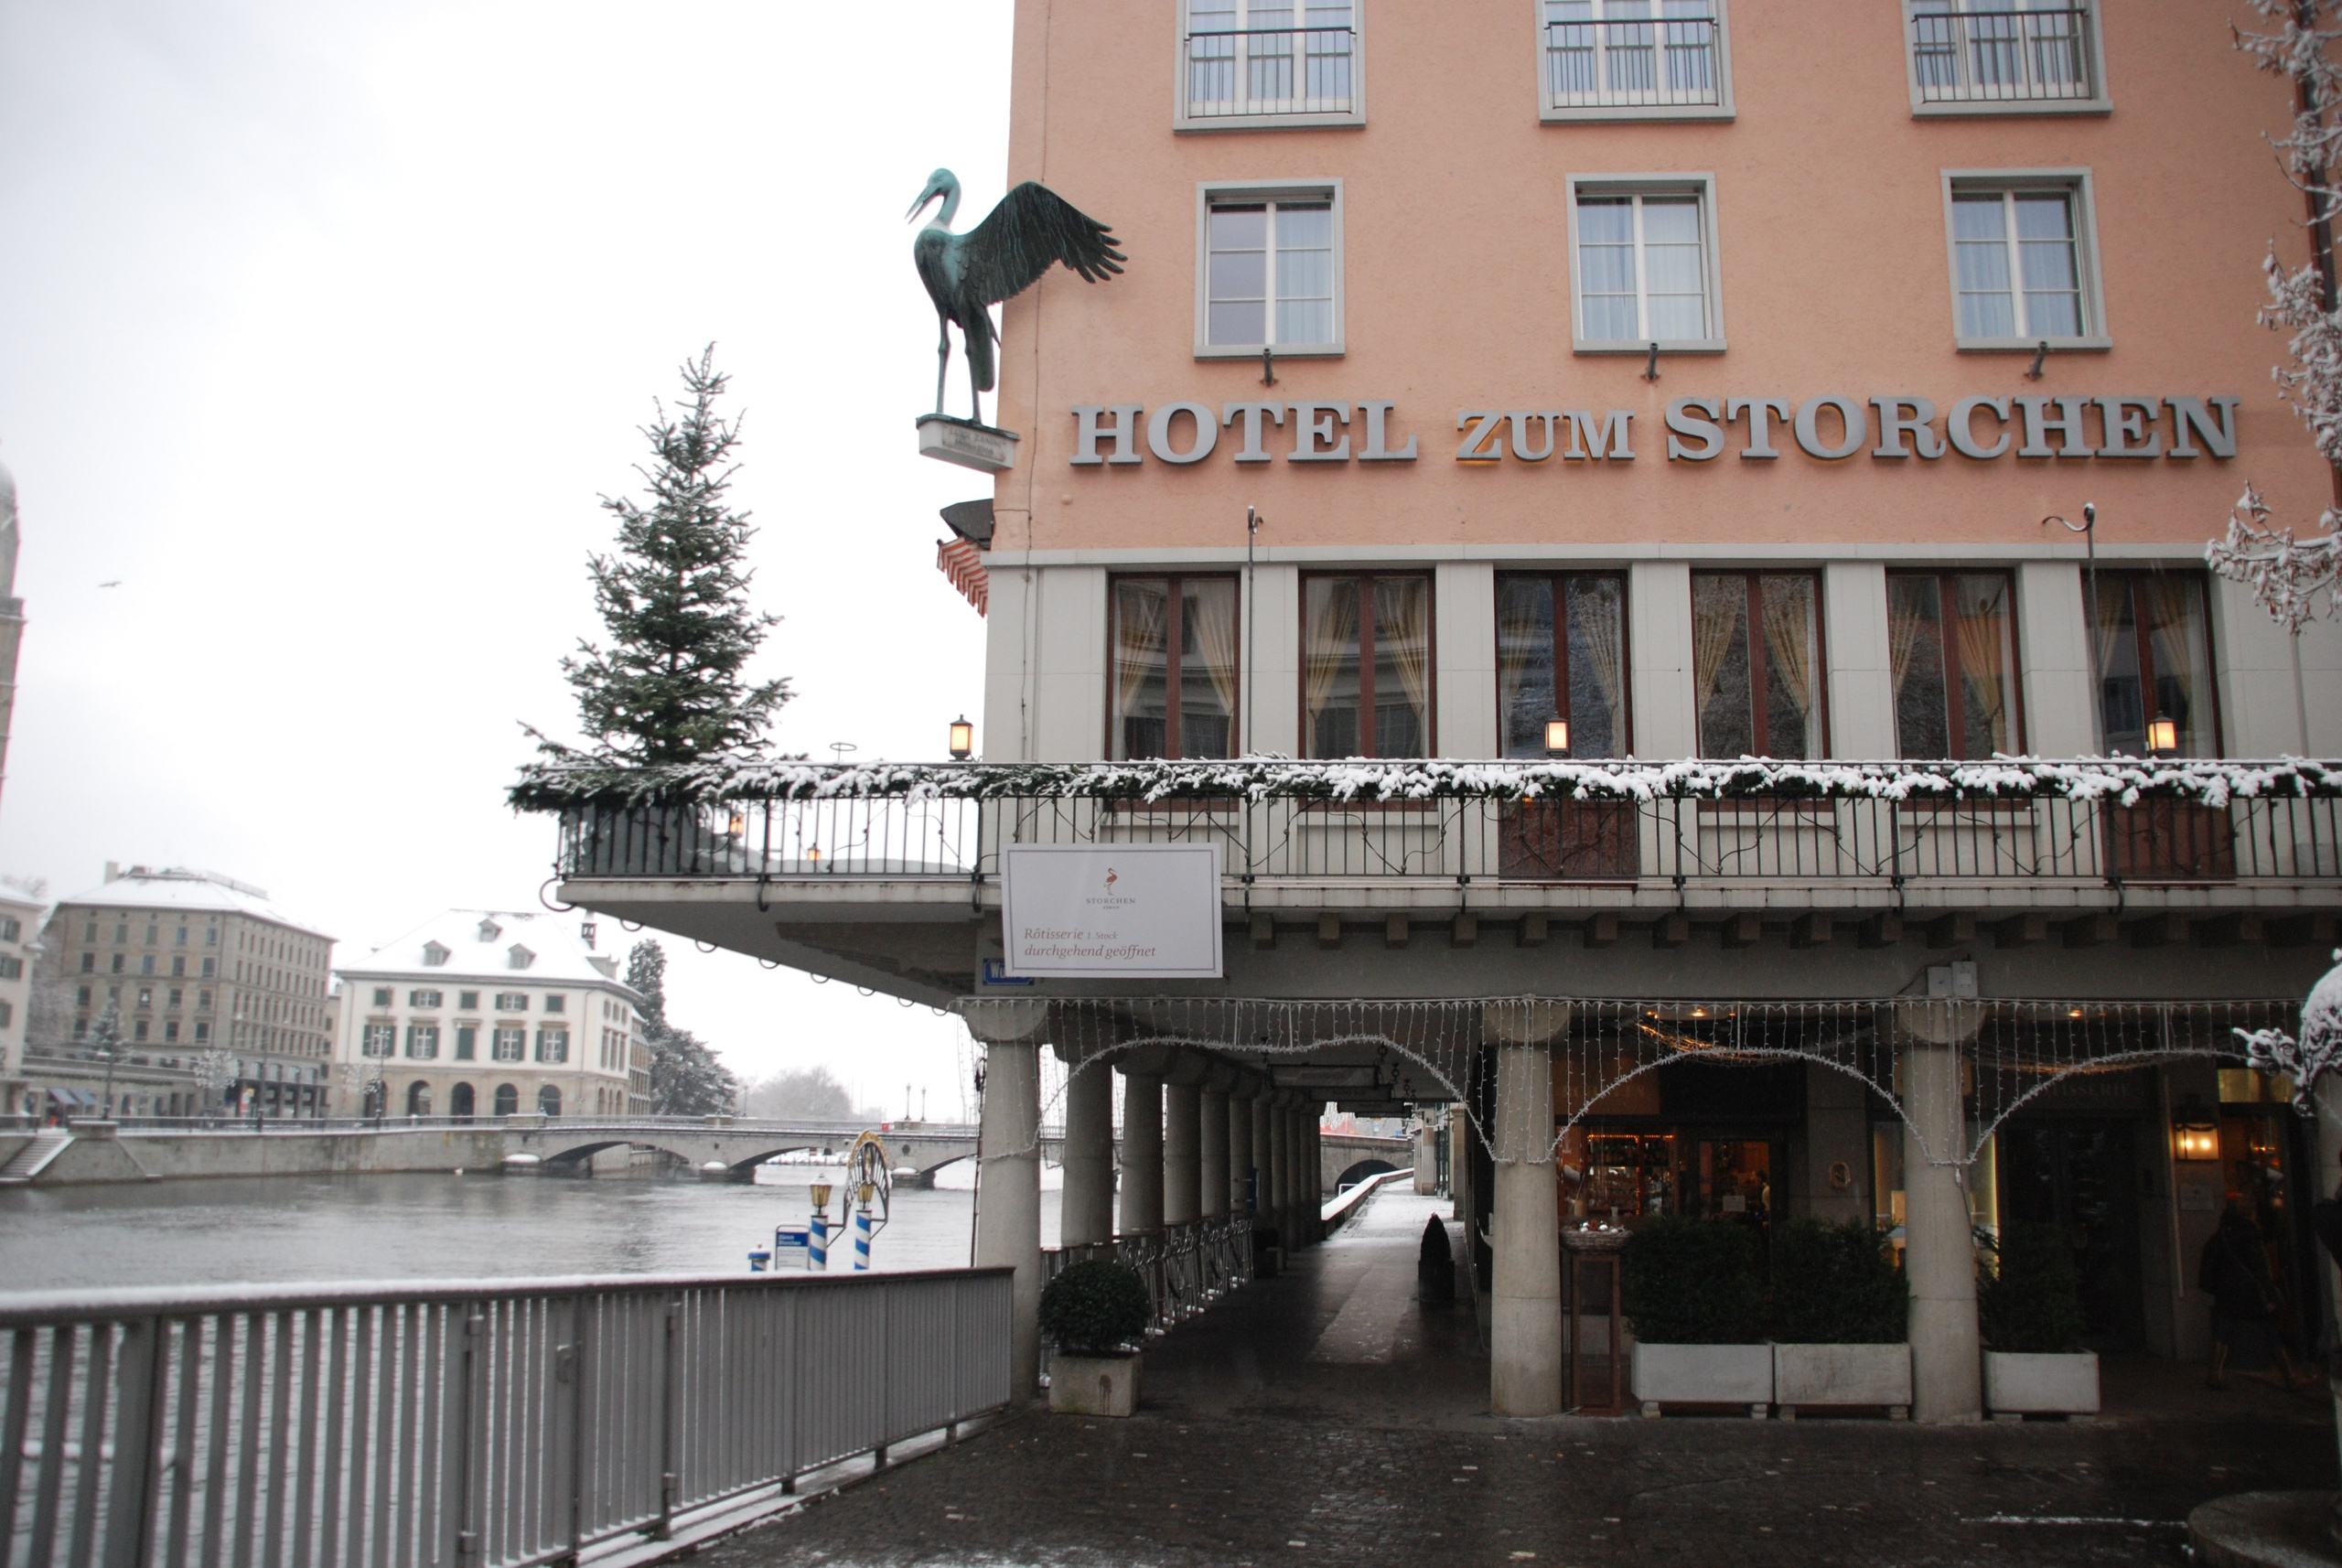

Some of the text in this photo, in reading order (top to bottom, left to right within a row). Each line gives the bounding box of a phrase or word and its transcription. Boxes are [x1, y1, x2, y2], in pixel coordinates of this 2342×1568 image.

[1069, 393, 2242, 468] HOTEL ZUM STORCHEN
[1024, 928, 1084, 940] Rôtisserie
[1095, 930, 1119, 940] Stock
[1024, 944, 1156, 960] durchgehend geöffnet
